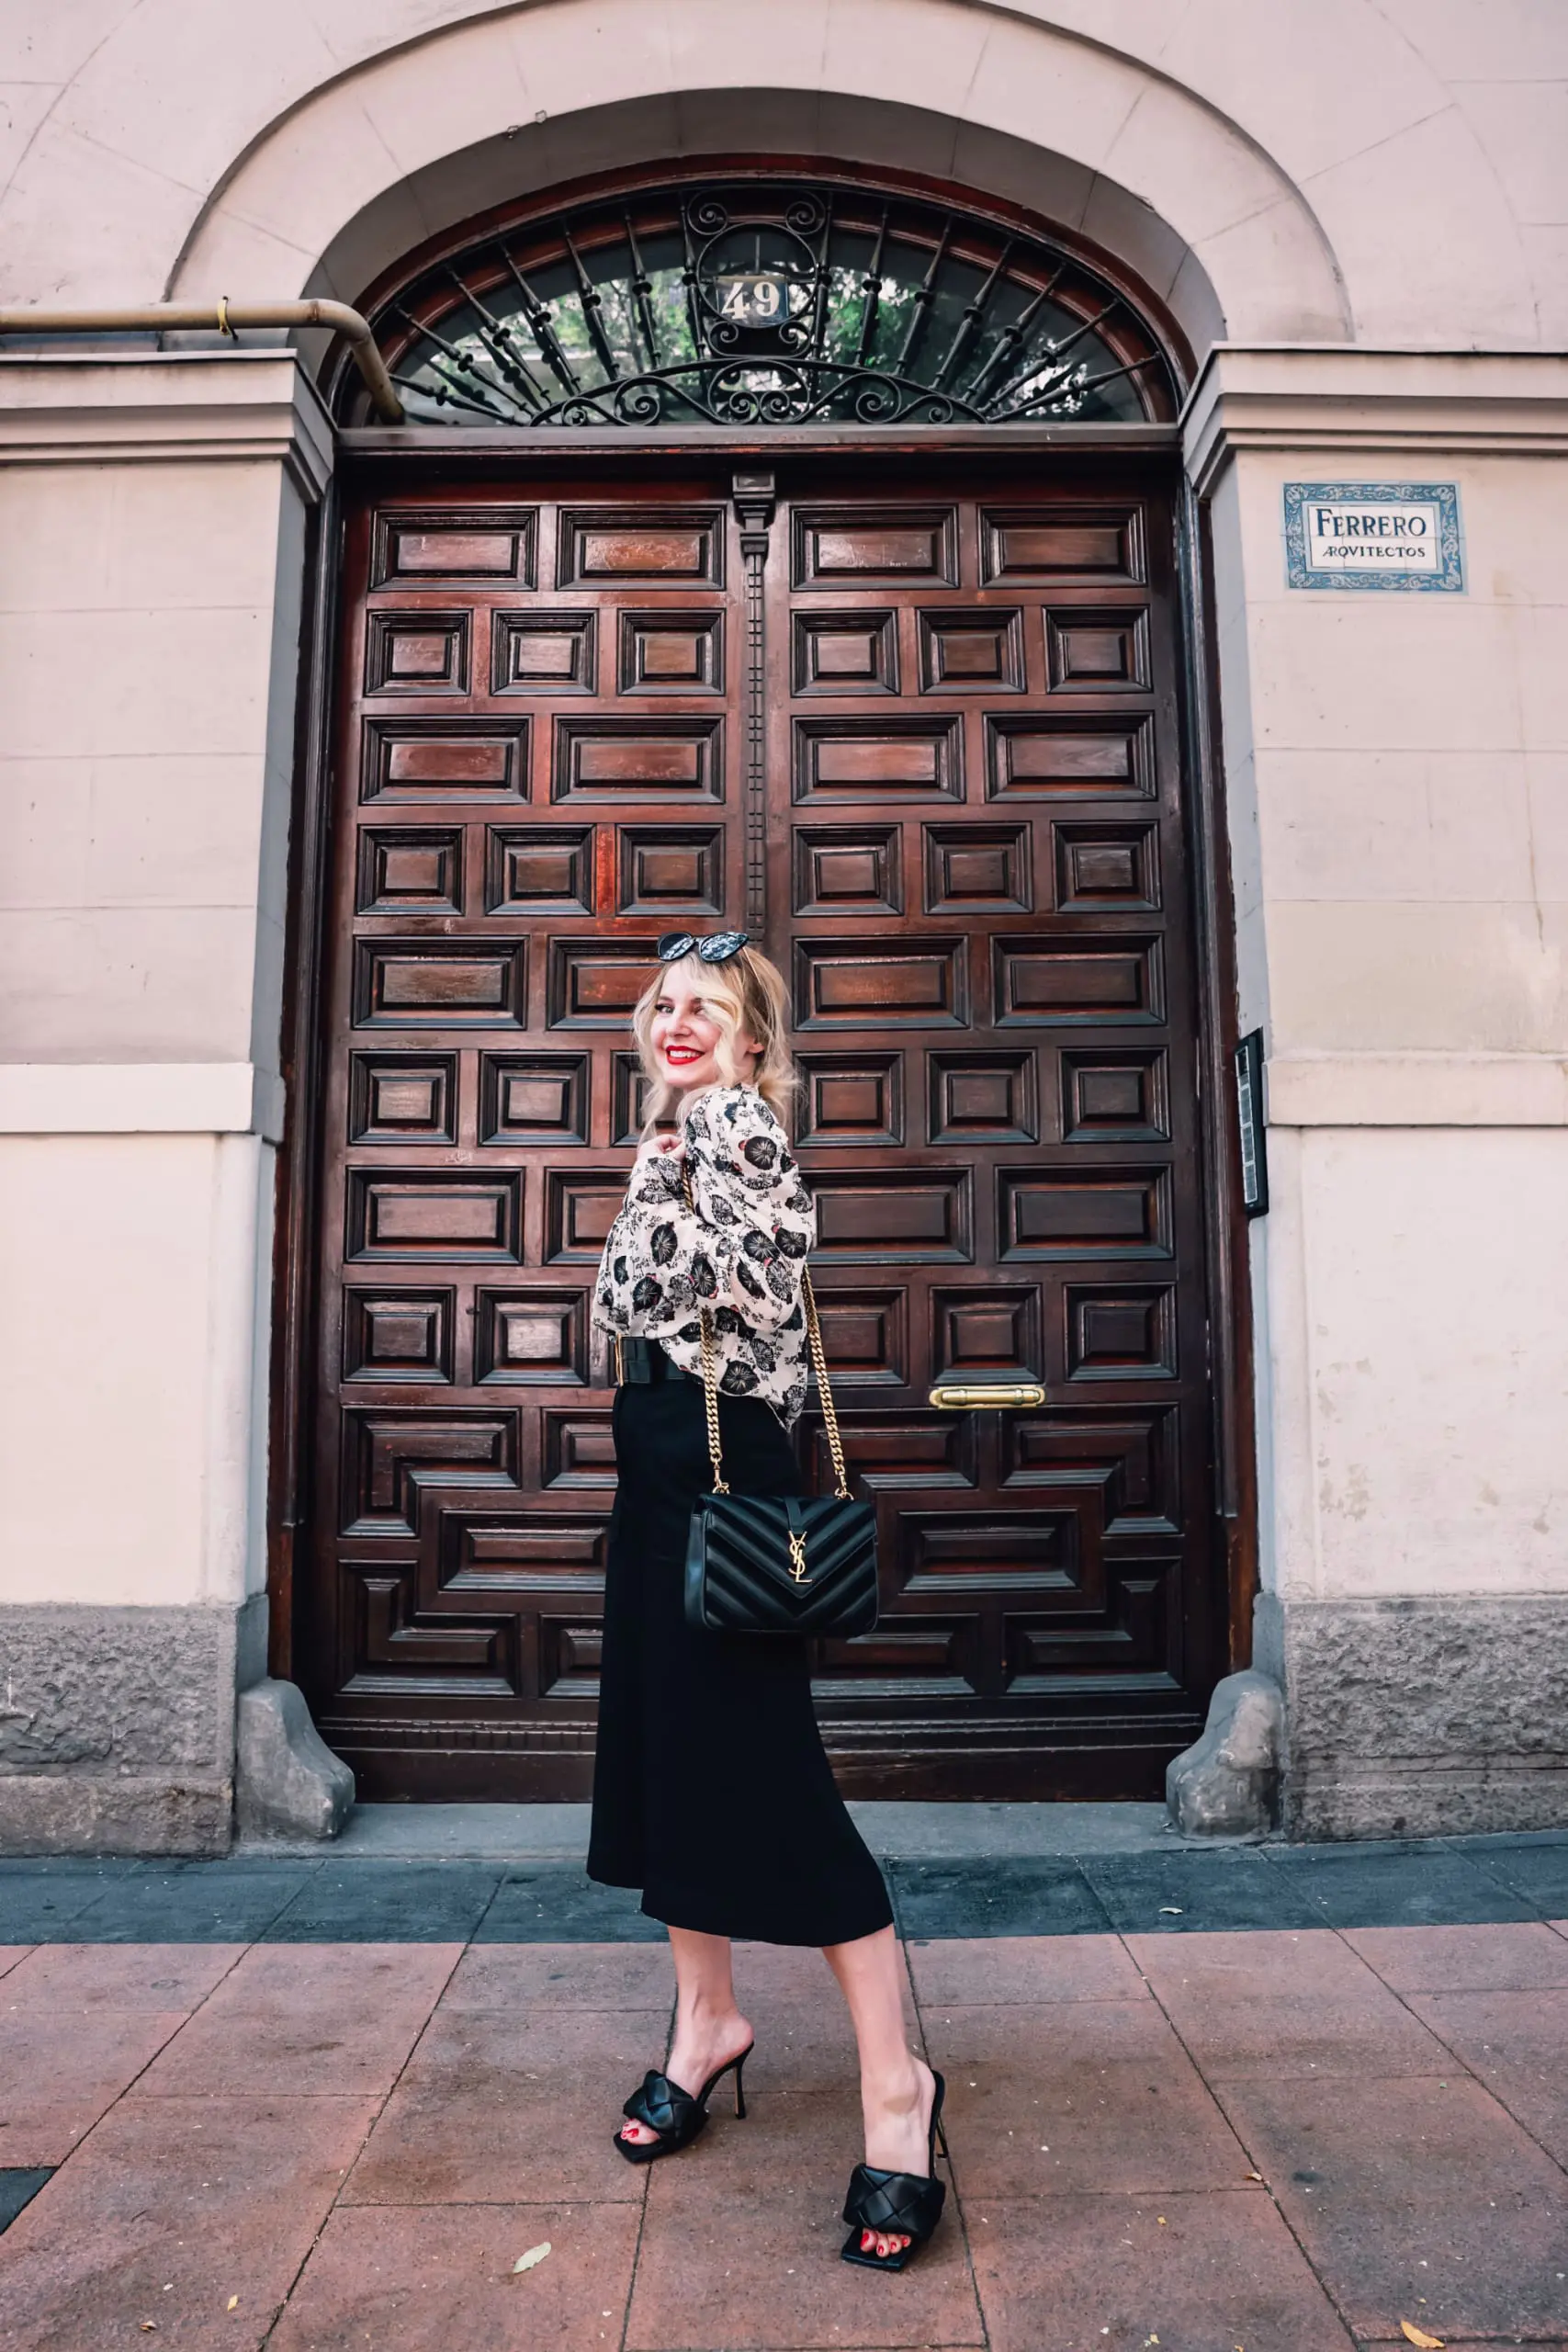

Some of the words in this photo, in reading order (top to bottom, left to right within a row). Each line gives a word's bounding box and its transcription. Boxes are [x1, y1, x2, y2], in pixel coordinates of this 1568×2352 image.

[721, 281, 780, 320] 49
[1316, 508, 1427, 537] FERRERO
[788, 1531, 813, 1583] YSL
